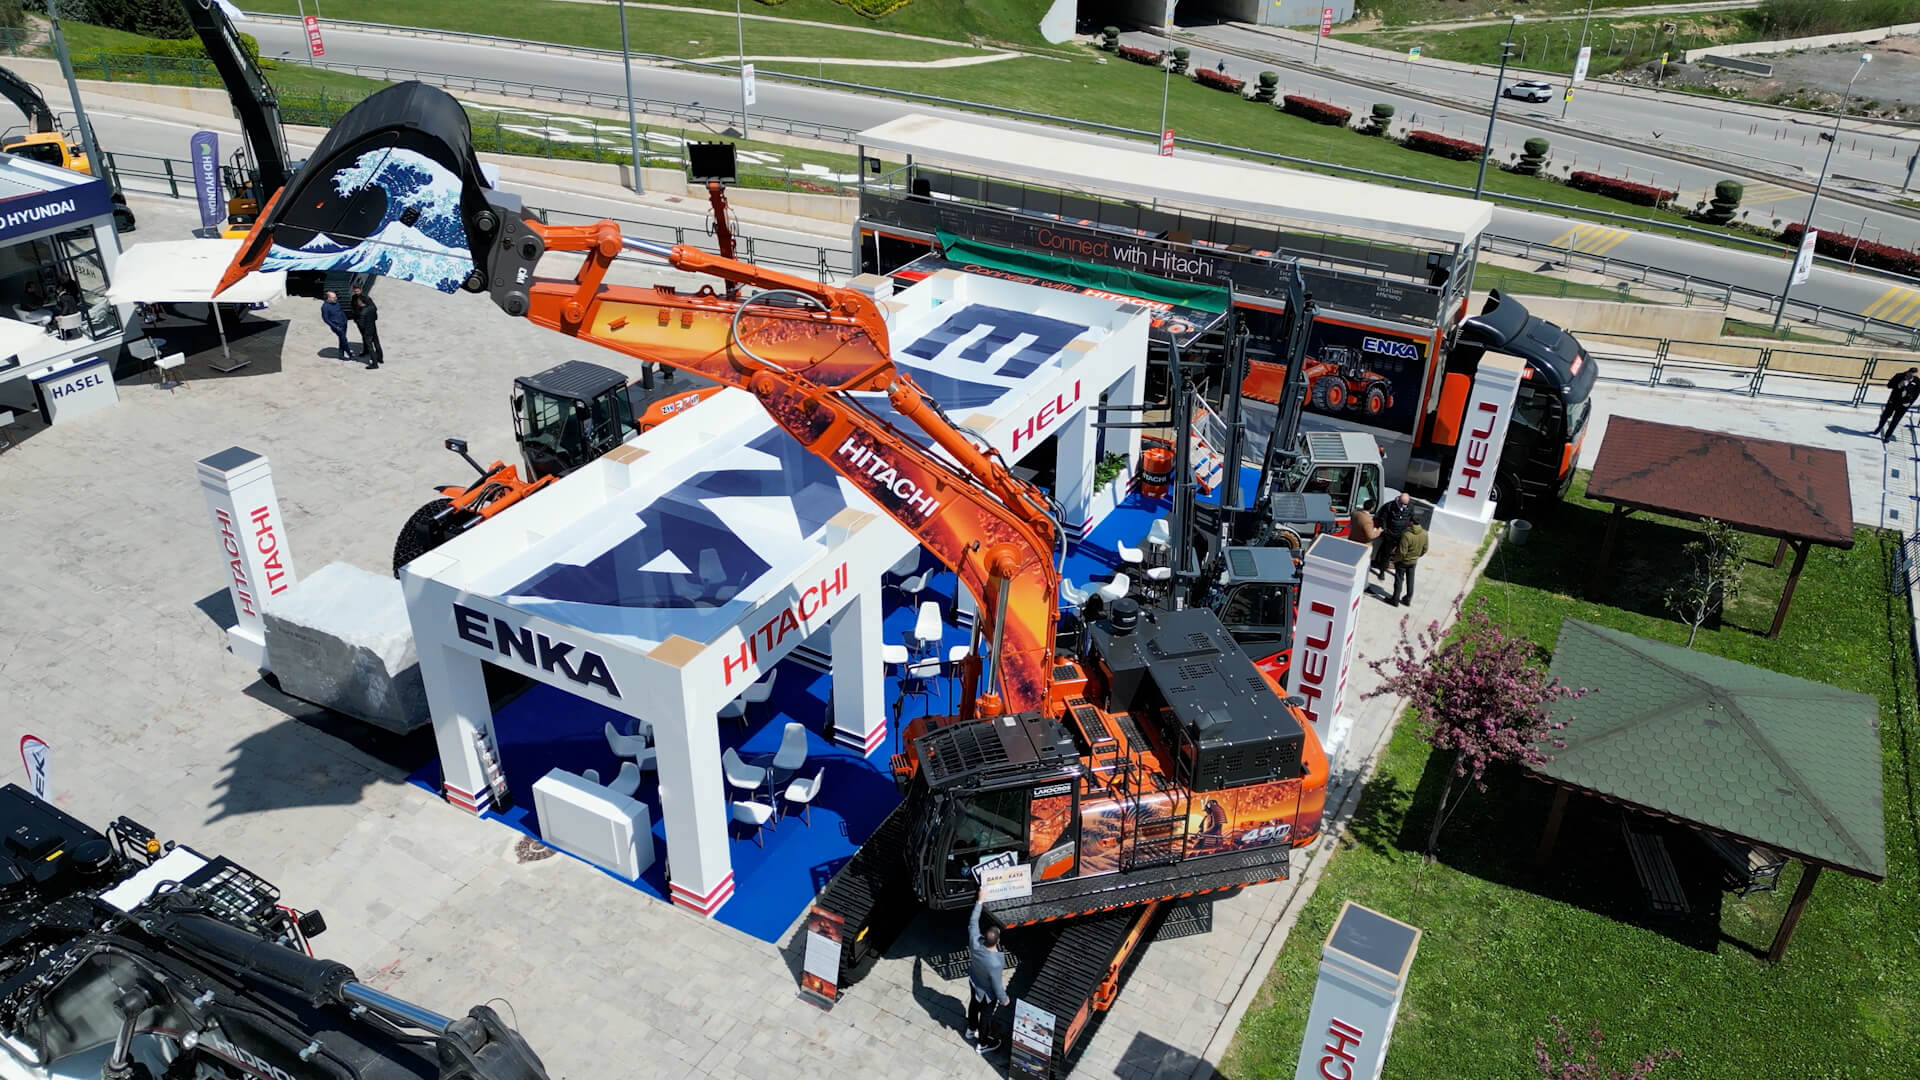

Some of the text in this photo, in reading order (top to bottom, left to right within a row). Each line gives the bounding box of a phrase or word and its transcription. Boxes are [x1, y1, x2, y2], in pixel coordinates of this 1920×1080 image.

[7, 199, 76, 227] HYUNDAI
[202, 156, 217, 216] HD HYUNDAI
[963, 264, 1038, 285] Connect
[1038, 228, 1214, 278] Connect with Hitachi
[52, 373, 104, 399] HASEL
[1362, 336, 1419, 360] ENKA
[1012, 379, 1081, 452] HELI
[1457, 402, 1499, 499] HELI
[838, 437, 940, 518] HITACHI
[215, 508, 256, 617] HITACHI
[249, 505, 288, 595] ITACHI
[453, 602, 623, 700] ENKA
[723, 561, 848, 687] HITACHI
[1299, 601, 1336, 722] HELI
